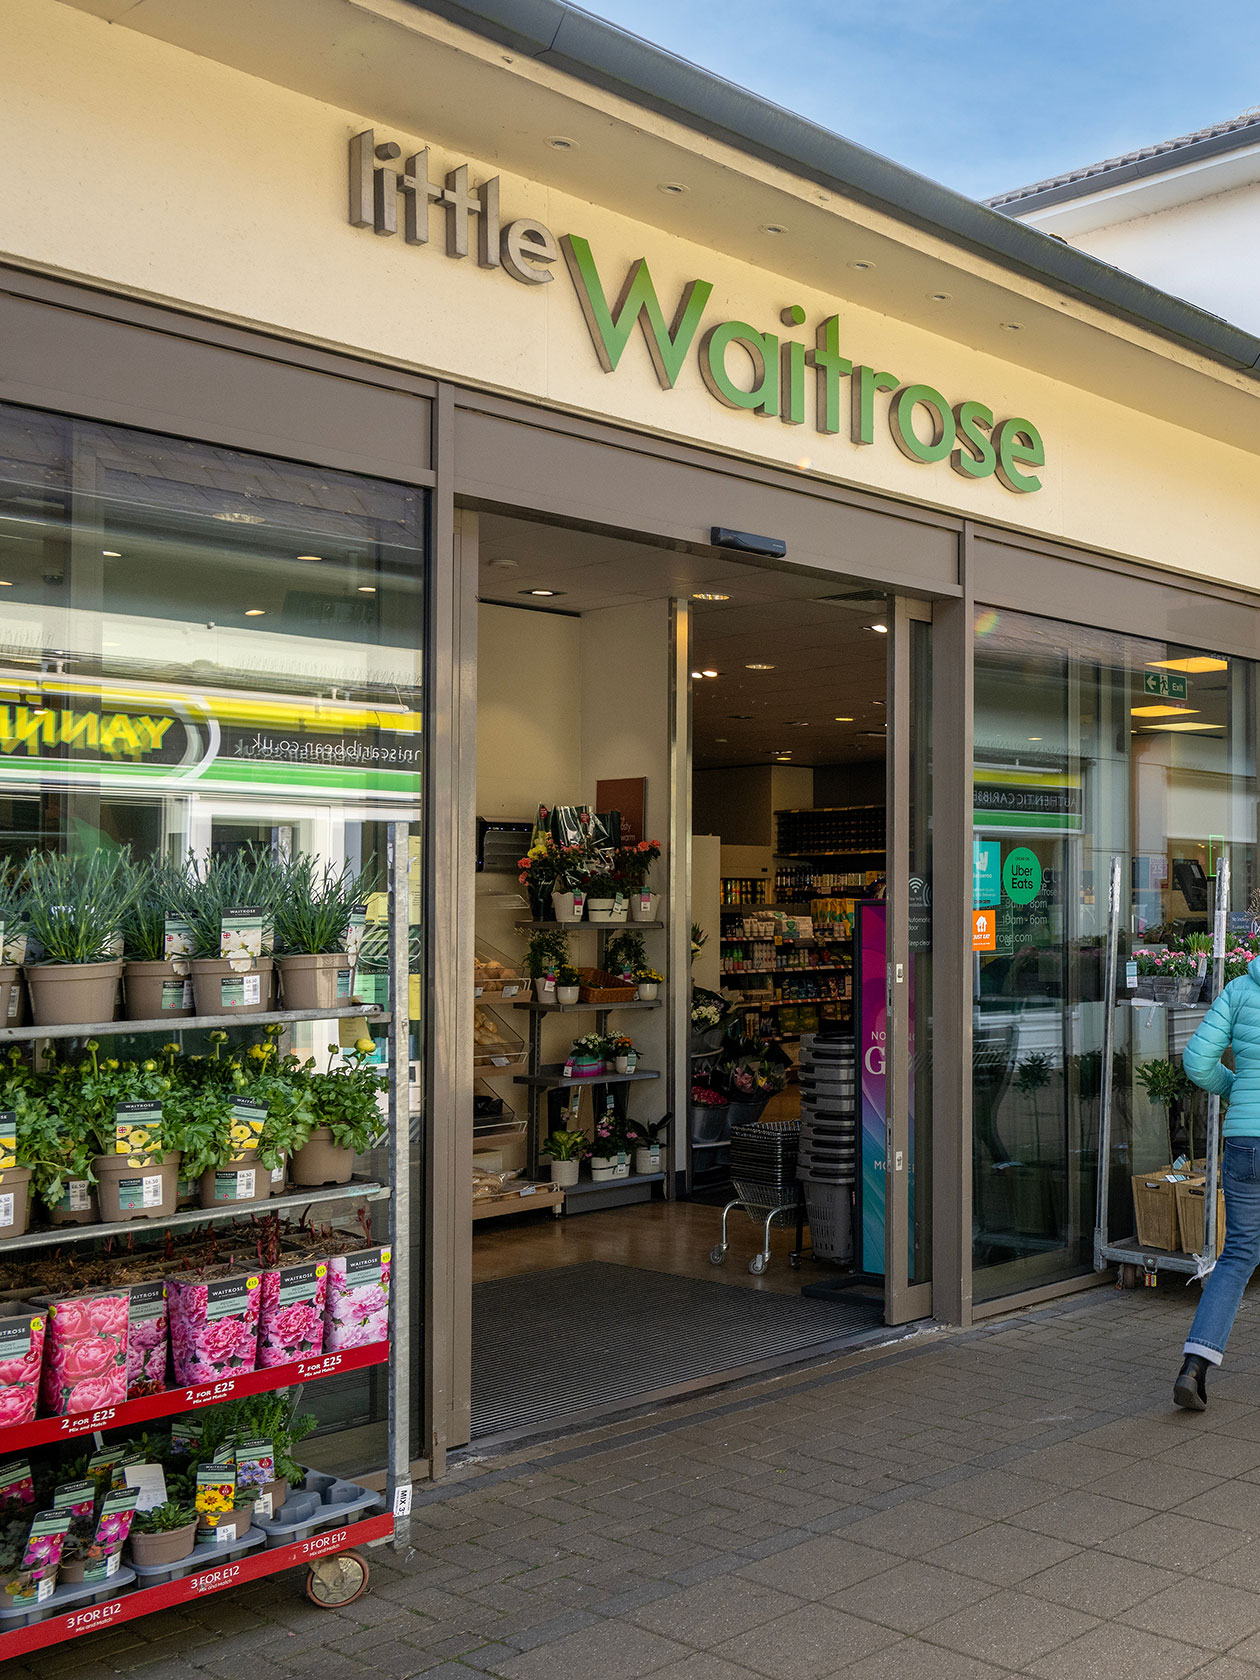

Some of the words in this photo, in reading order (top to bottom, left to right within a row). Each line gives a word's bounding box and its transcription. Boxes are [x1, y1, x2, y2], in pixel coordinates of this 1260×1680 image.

[350, 128, 558, 285] little
[559, 234, 1046, 494] Waitrose
[1171, 682, 1184, 693] Exit
[1011, 864, 1033, 877] Uber
[1011, 877, 1034, 890] Eats
[1029, 914, 1048, 928] 6pm
[349, 1257, 378, 1268] WAITROSE
[284, 1272, 314, 1283] WAITROSE
[212, 1286, 244, 1297] WAITROSE
[297, 1363, 305, 1374] 2
[307, 1363, 321, 1372] FOR
[322, 1355, 342, 1368] £25
[321, 1366, 336, 1374] Match
[185, 1390, 194, 1401] 2
[196, 1390, 212, 1399] FOR
[213, 1380, 235, 1394] £25
[203, 1395, 212, 1403] and
[212, 1392, 228, 1401] Match
[61, 1418, 70, 1430] 2
[72, 1417, 89, 1427] FOR
[92, 1408, 116, 1423] £25
[68, 1425, 79, 1433] Mix
[79, 1423, 90, 1431] and
[89, 1420, 107, 1429] Match
[243, 1439, 265, 1447] WAITROSE
[64, 1481, 88, 1491] WAITROSE
[114, 1488, 135, 1497] WAITROSE
[400, 1489, 408, 1506] MIX
[43, 1510, 67, 1518] WAITROSE
[302, 1543, 310, 1554] 3
[310, 1536, 331, 1551] FOR
[325, 1543, 340, 1552] Match
[190, 1578, 199, 1590] 3
[199, 1571, 221, 1585] FOR
[207, 1583, 218, 1591] and
[218, 1578, 233, 1587] Match
[66, 1617, 76, 1629] 3
[76, 1610, 101, 1625] FOR
[75, 1625, 85, 1633] Mix
[85, 1622, 97, 1630] and
[97, 1617, 113, 1627] Match
